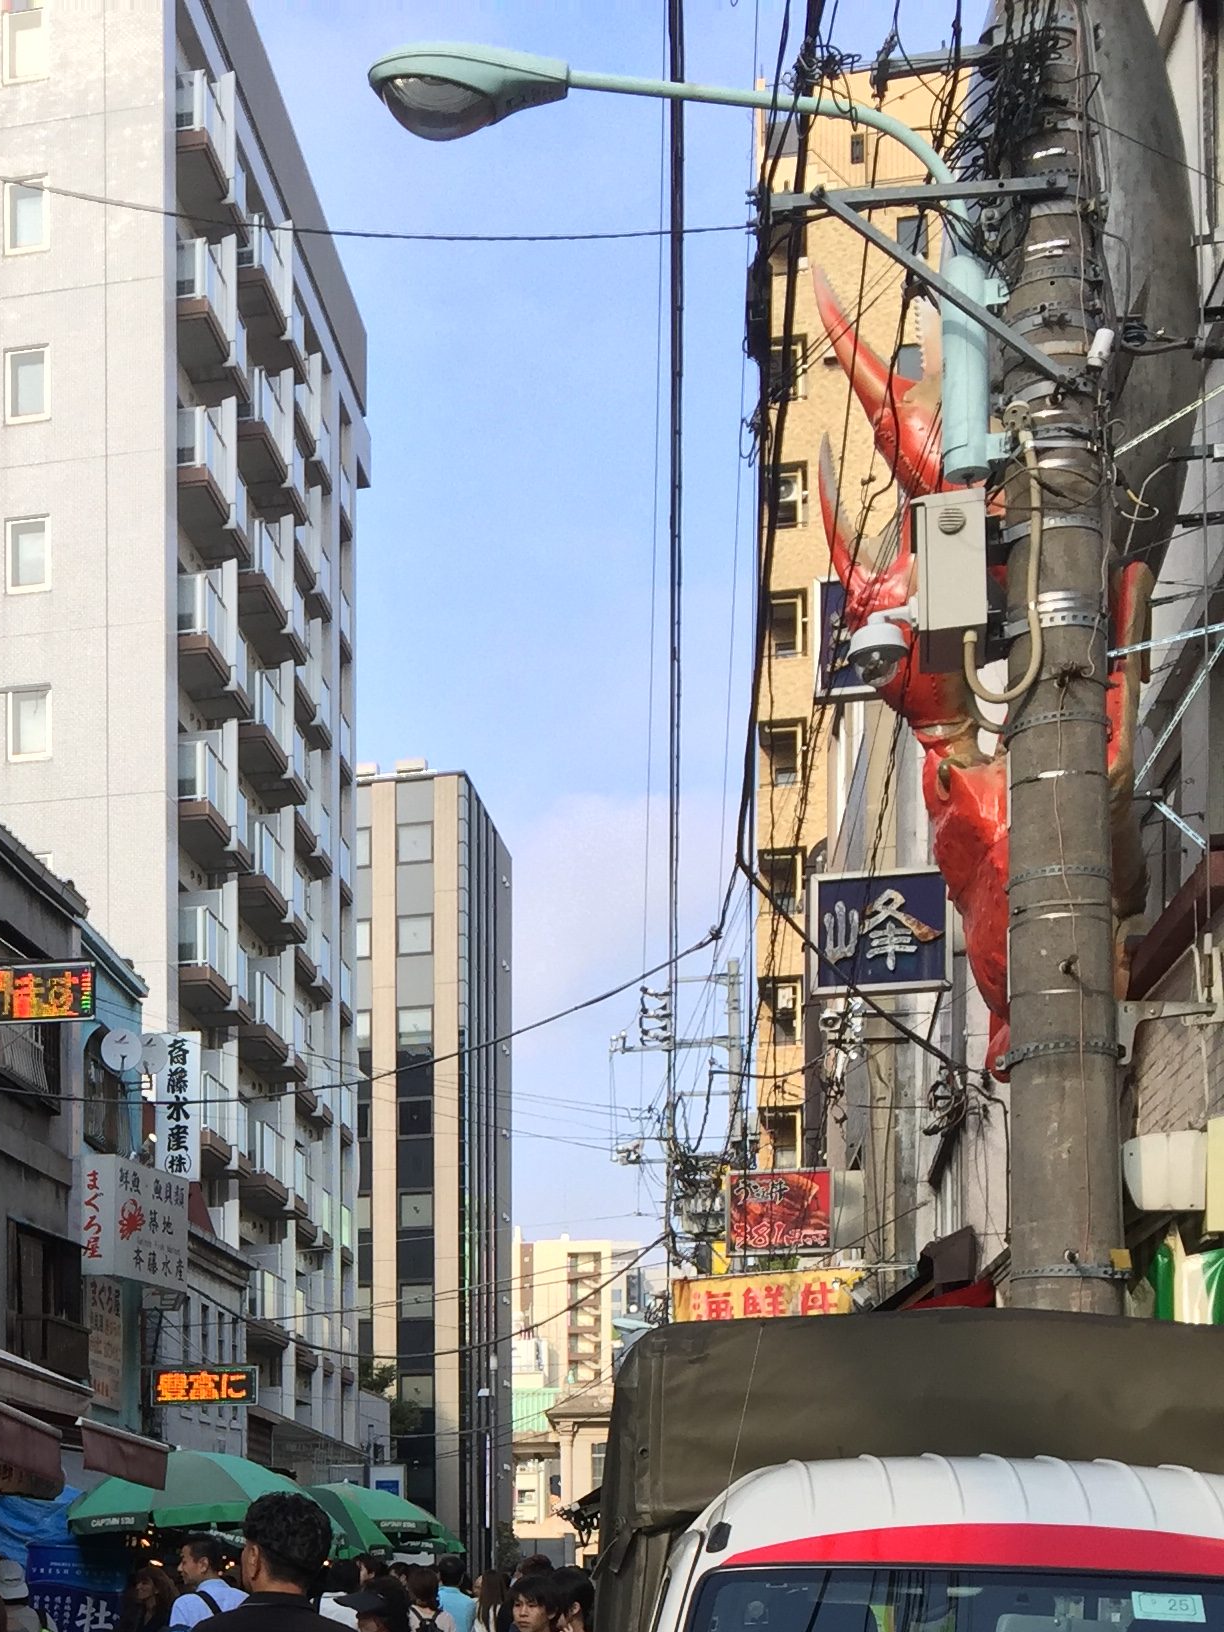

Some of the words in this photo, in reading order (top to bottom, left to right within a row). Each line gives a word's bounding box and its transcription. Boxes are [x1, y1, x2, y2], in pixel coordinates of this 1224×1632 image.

[82, 1169, 104, 1259] まぐろ屋
[1168, 1598, 1189, 1611] 25
